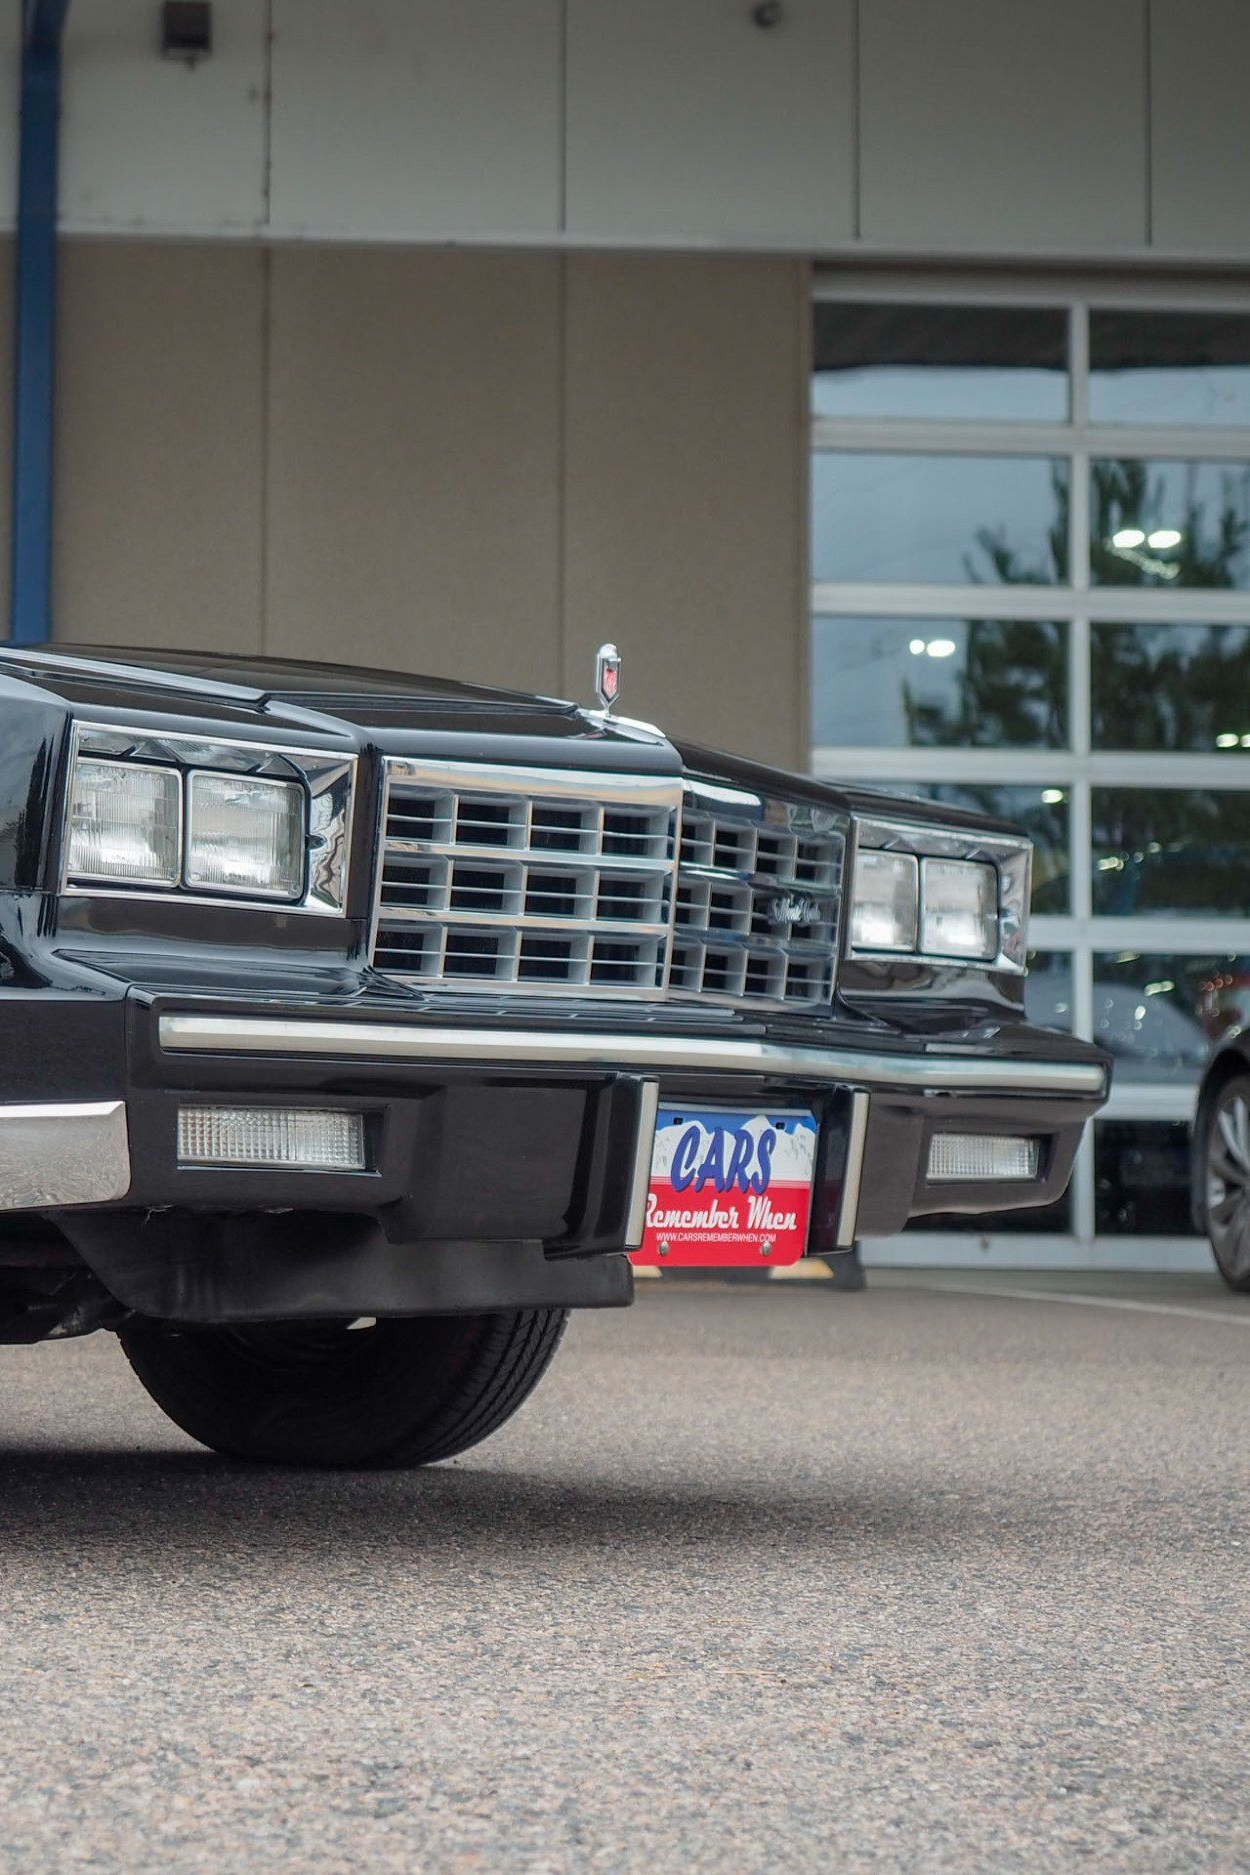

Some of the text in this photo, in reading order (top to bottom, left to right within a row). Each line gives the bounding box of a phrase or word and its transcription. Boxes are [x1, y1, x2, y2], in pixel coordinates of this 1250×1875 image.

[670, 1125, 777, 1195] CARS
[646, 1193, 797, 1230] Remember When
